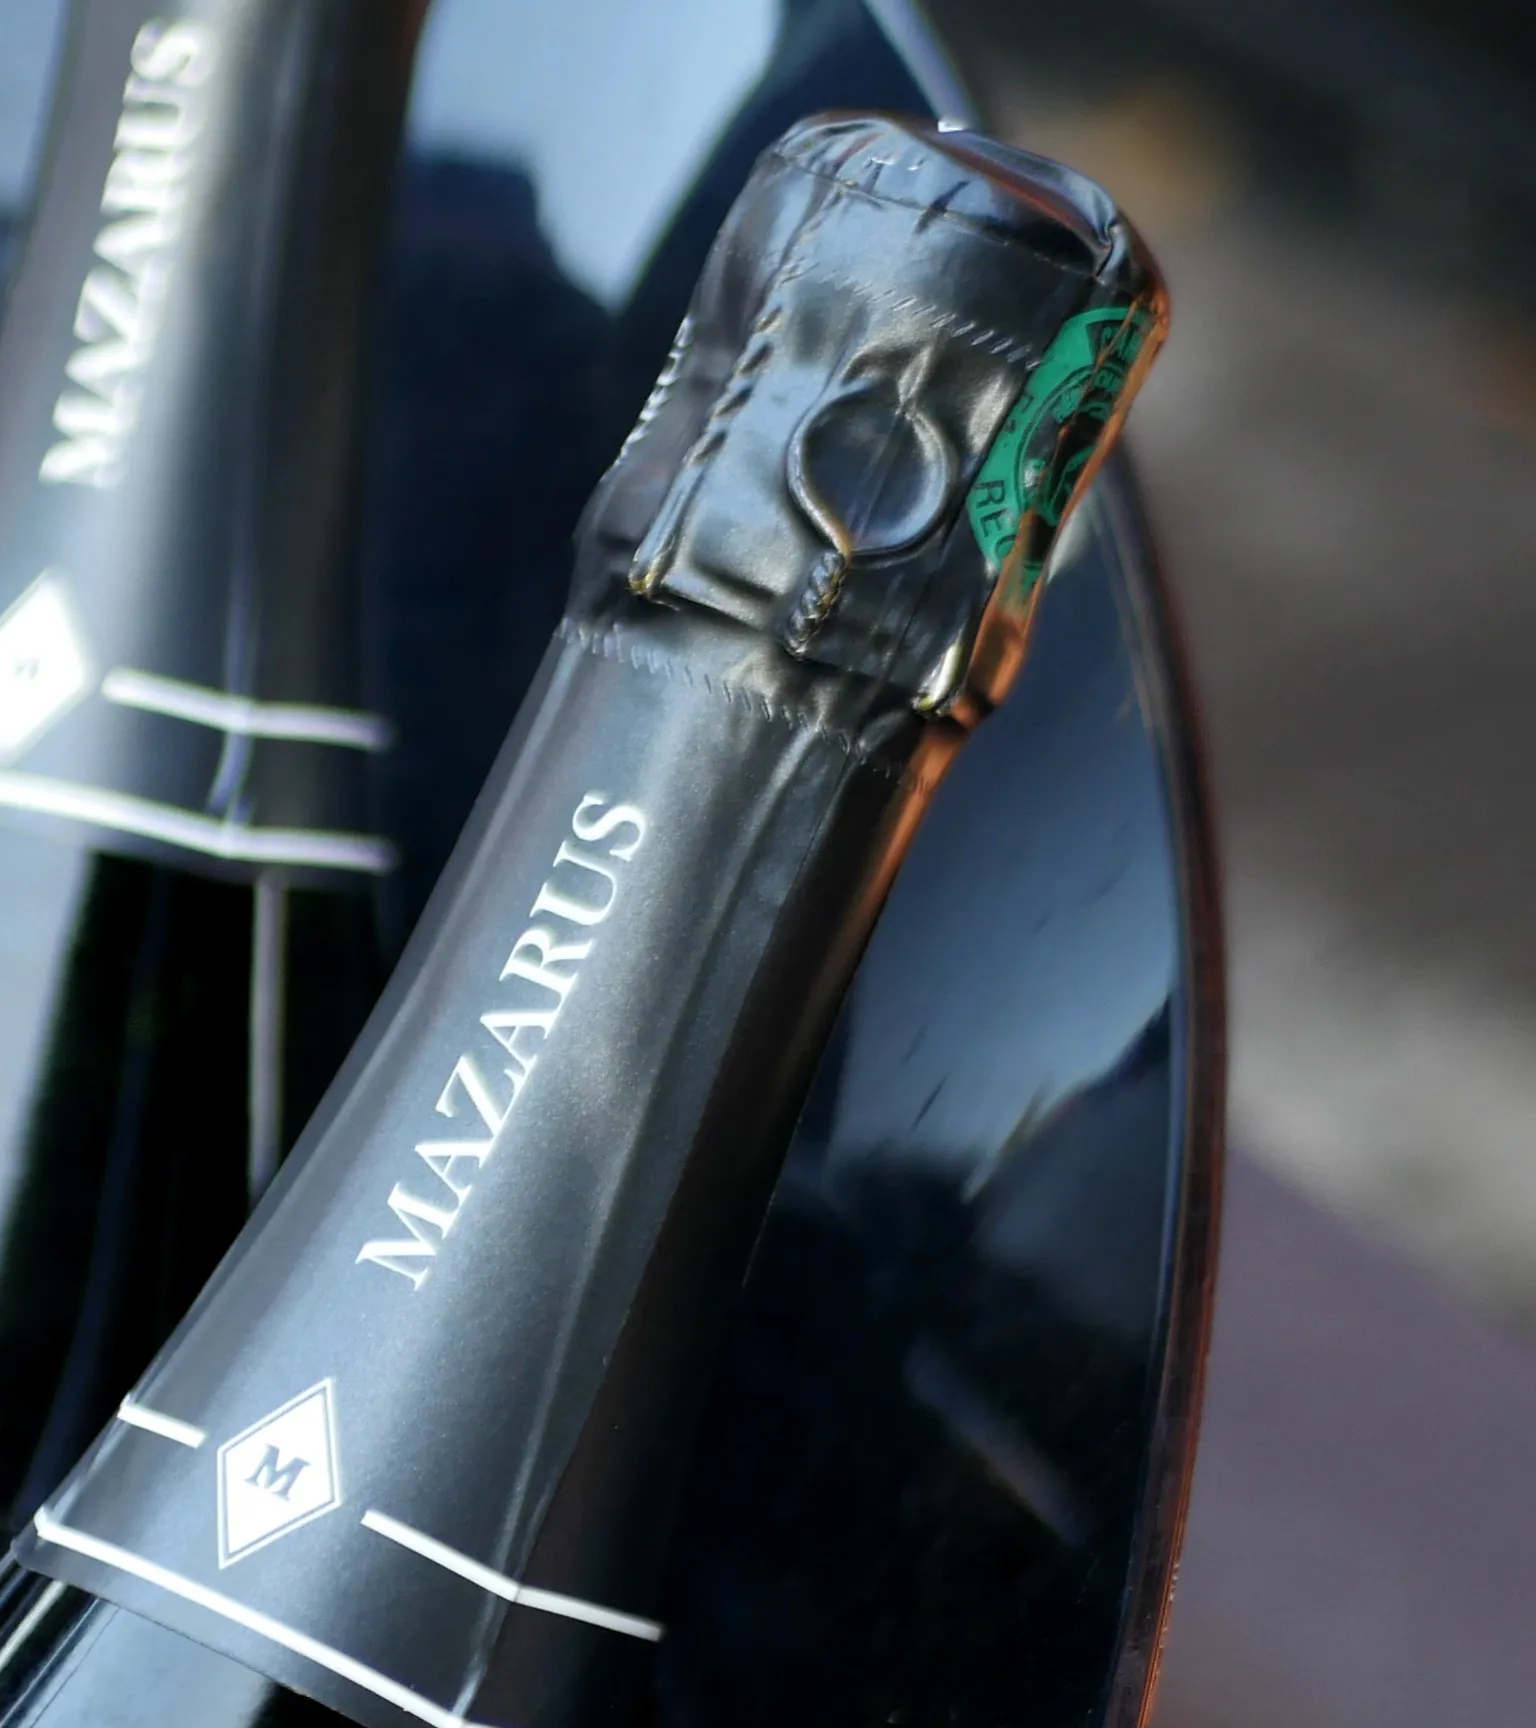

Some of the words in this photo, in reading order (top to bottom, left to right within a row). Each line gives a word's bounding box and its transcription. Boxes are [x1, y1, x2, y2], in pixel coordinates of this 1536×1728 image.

[39, 18, 216, 489] MAZARUS
[355, 791, 651, 1291] MAZARUS
[244, 1442, 311, 1501] M
